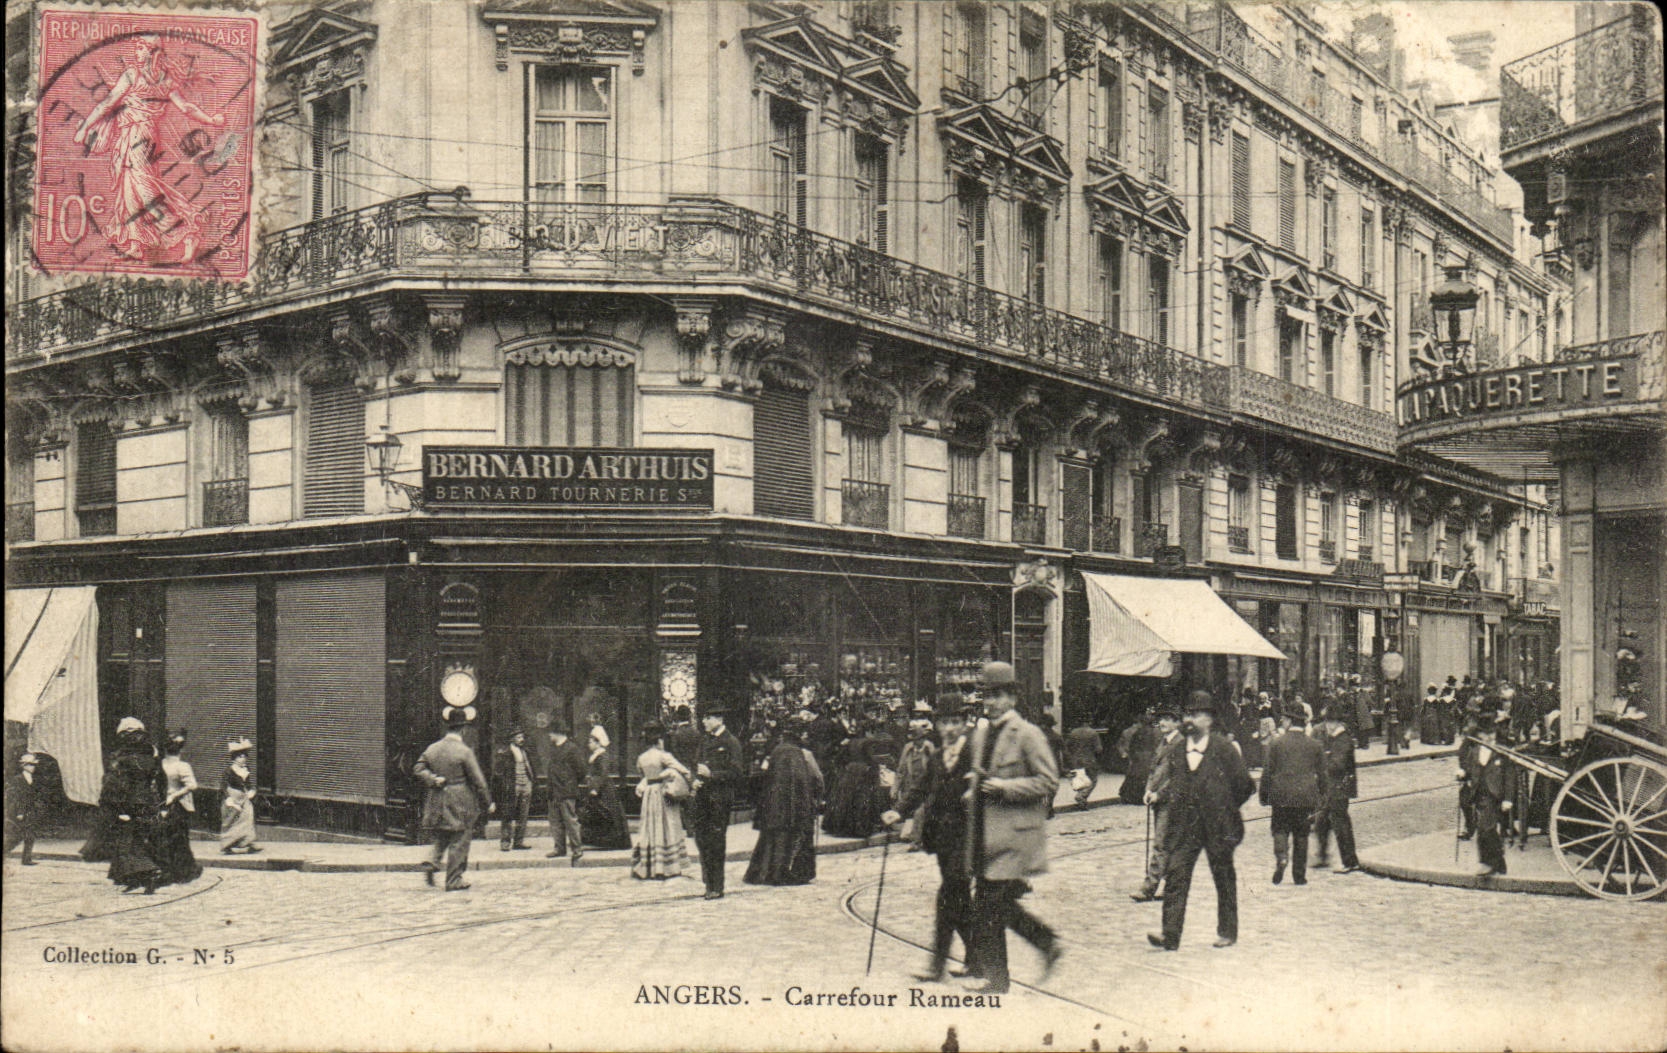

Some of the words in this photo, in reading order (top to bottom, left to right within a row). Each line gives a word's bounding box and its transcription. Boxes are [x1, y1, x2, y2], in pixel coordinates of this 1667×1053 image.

[220, 178, 241, 260] POSTES
[427, 453, 573, 479] BERNARD
[577, 455, 709, 480] ARTHUIS
[435, 486, 537, 501] BERNARD
[550, 487, 669, 502] TOURNERIE
